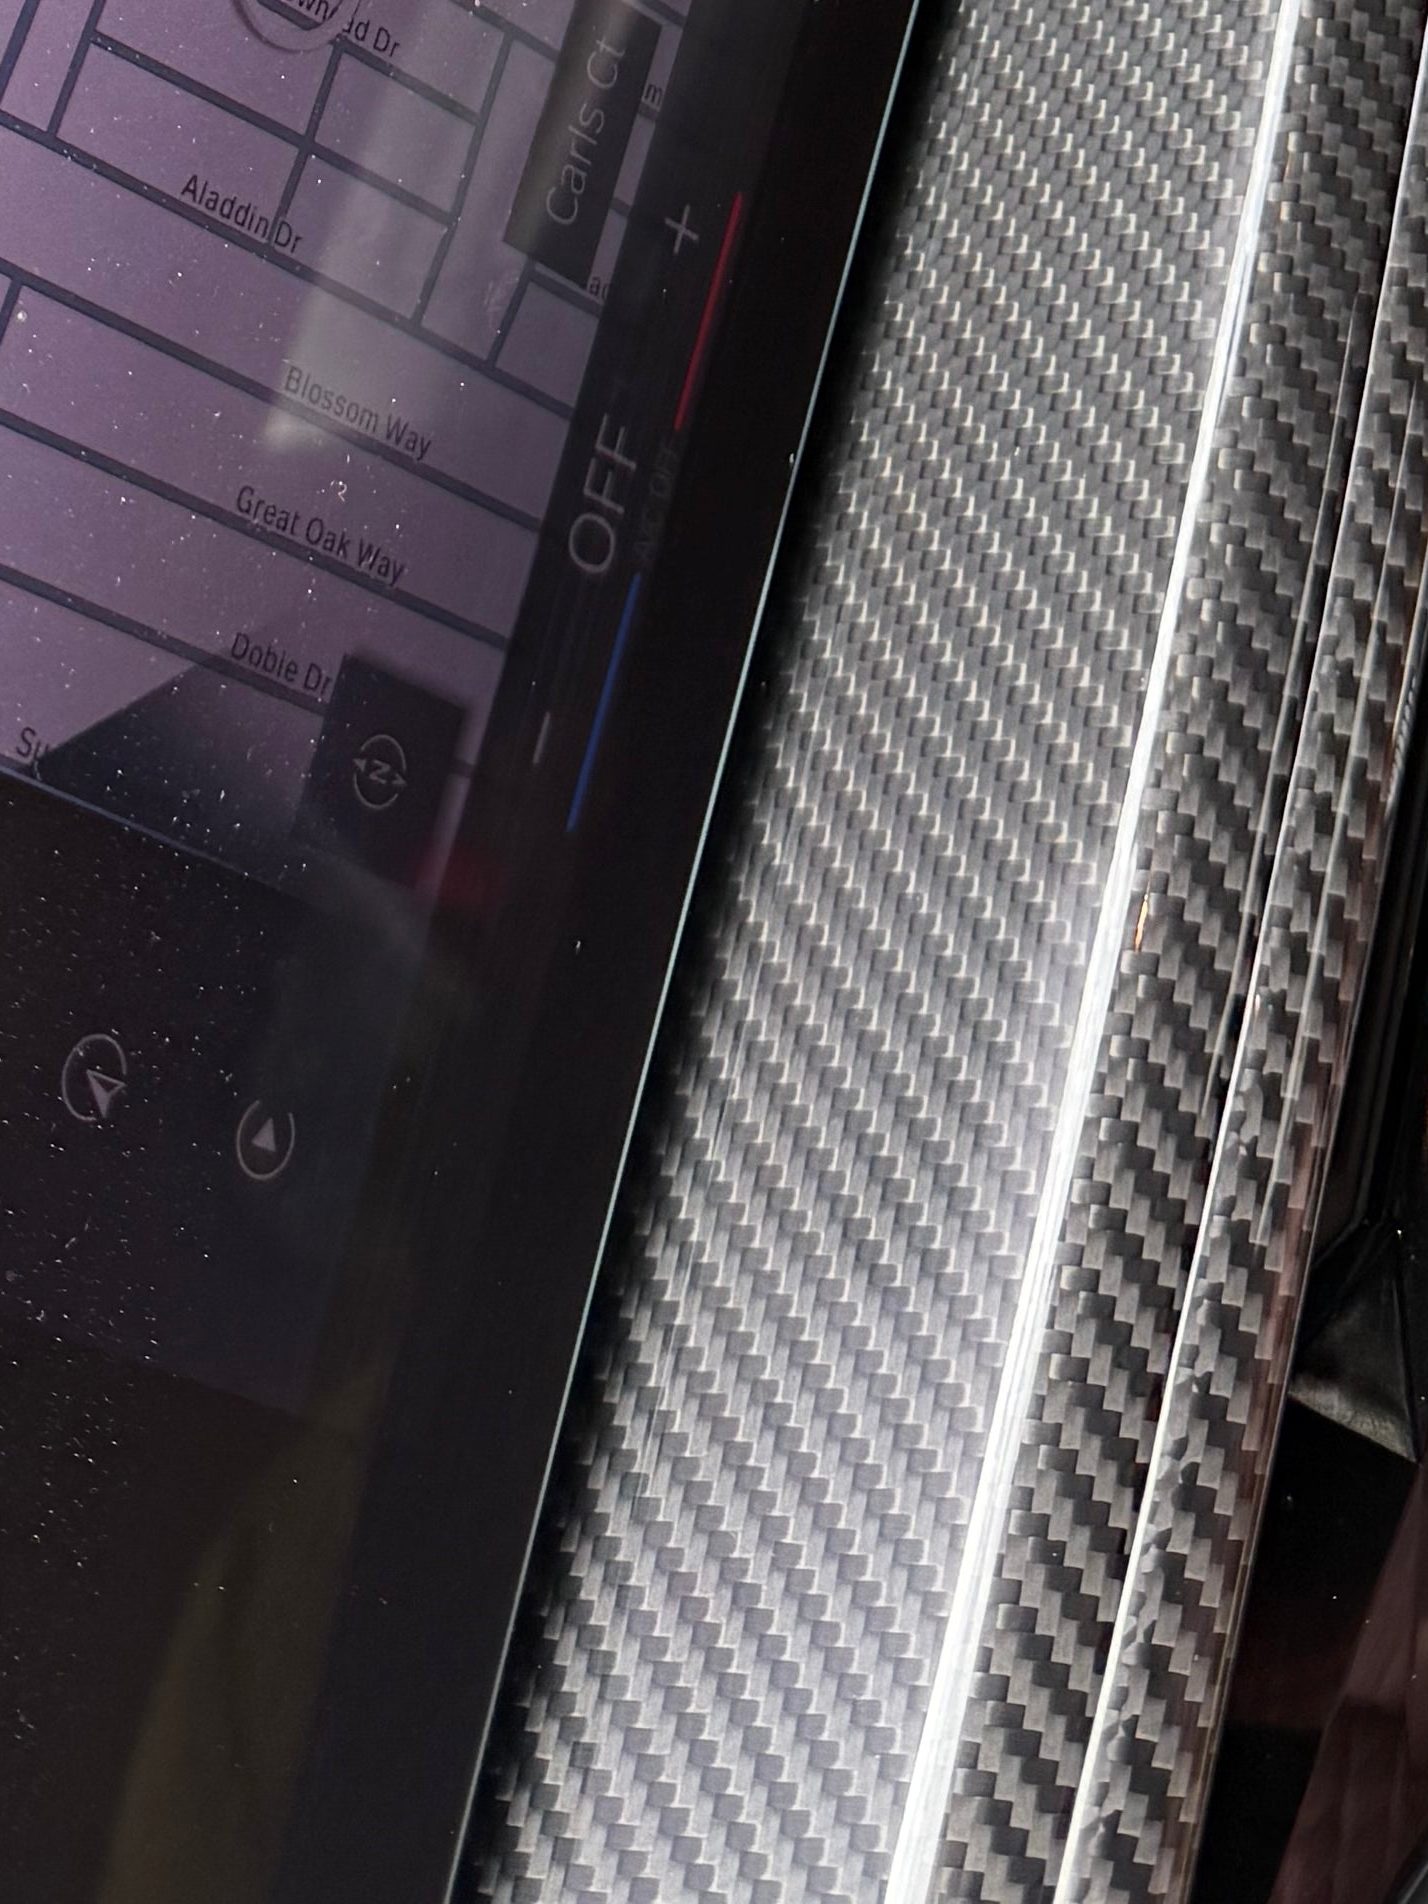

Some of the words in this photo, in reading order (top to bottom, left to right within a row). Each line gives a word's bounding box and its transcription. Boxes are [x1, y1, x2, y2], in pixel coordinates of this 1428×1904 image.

[373, 26, 401, 58] Dr
[545, 102, 606, 225] Carls
[586, 38, 626, 89] Ct
[180, 174, 270, 239] Aladdin
[274, 220, 303, 254] Dr
[283, 365, 379, 434] Blossom
[385, 413, 433, 462] Way
[236, 485, 301, 536] Great
[305, 517, 351, 560] Oak
[357, 539, 406, 588] Way
[567, 412, 637, 574] OFF
